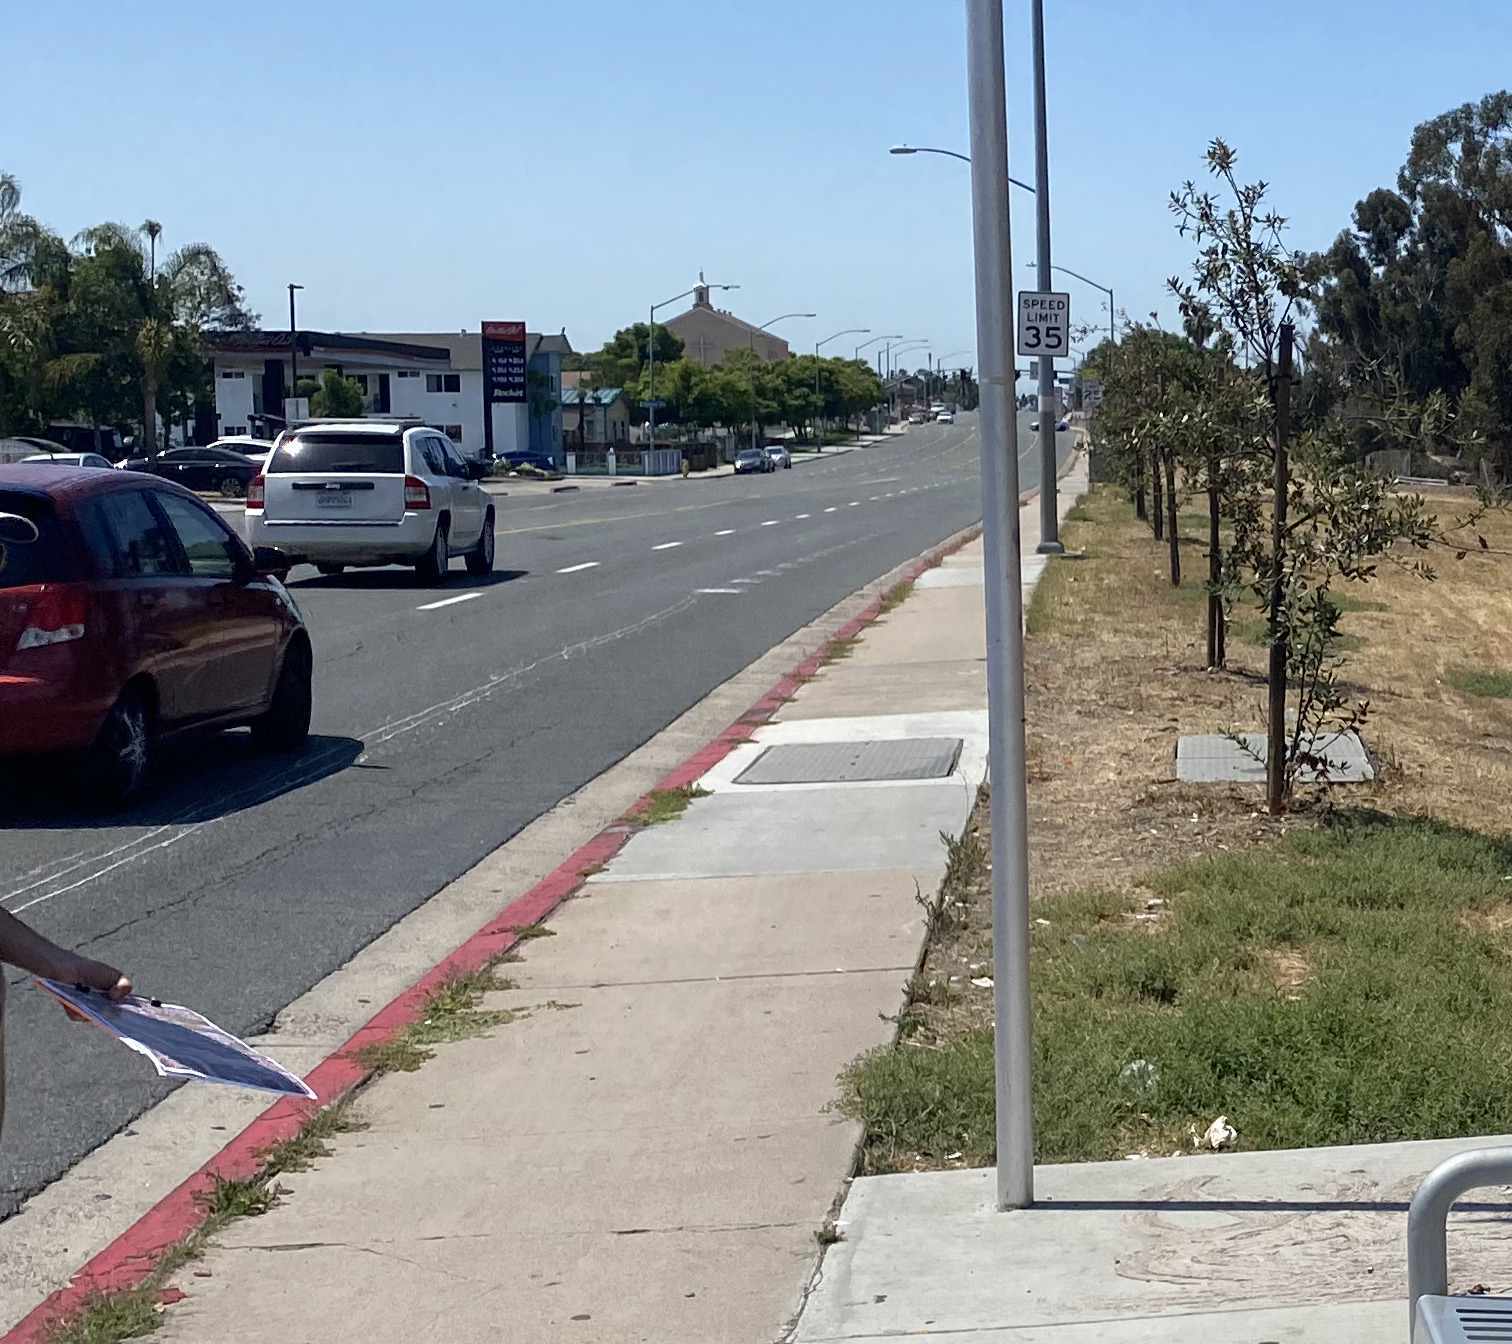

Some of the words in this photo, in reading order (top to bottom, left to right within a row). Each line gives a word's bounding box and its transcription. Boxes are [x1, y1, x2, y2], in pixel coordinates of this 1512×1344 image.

[1022, 298, 1066, 311] SPEED
[1026, 312, 1060, 324] LIMIT
[1024, 325, 1062, 349] 35
